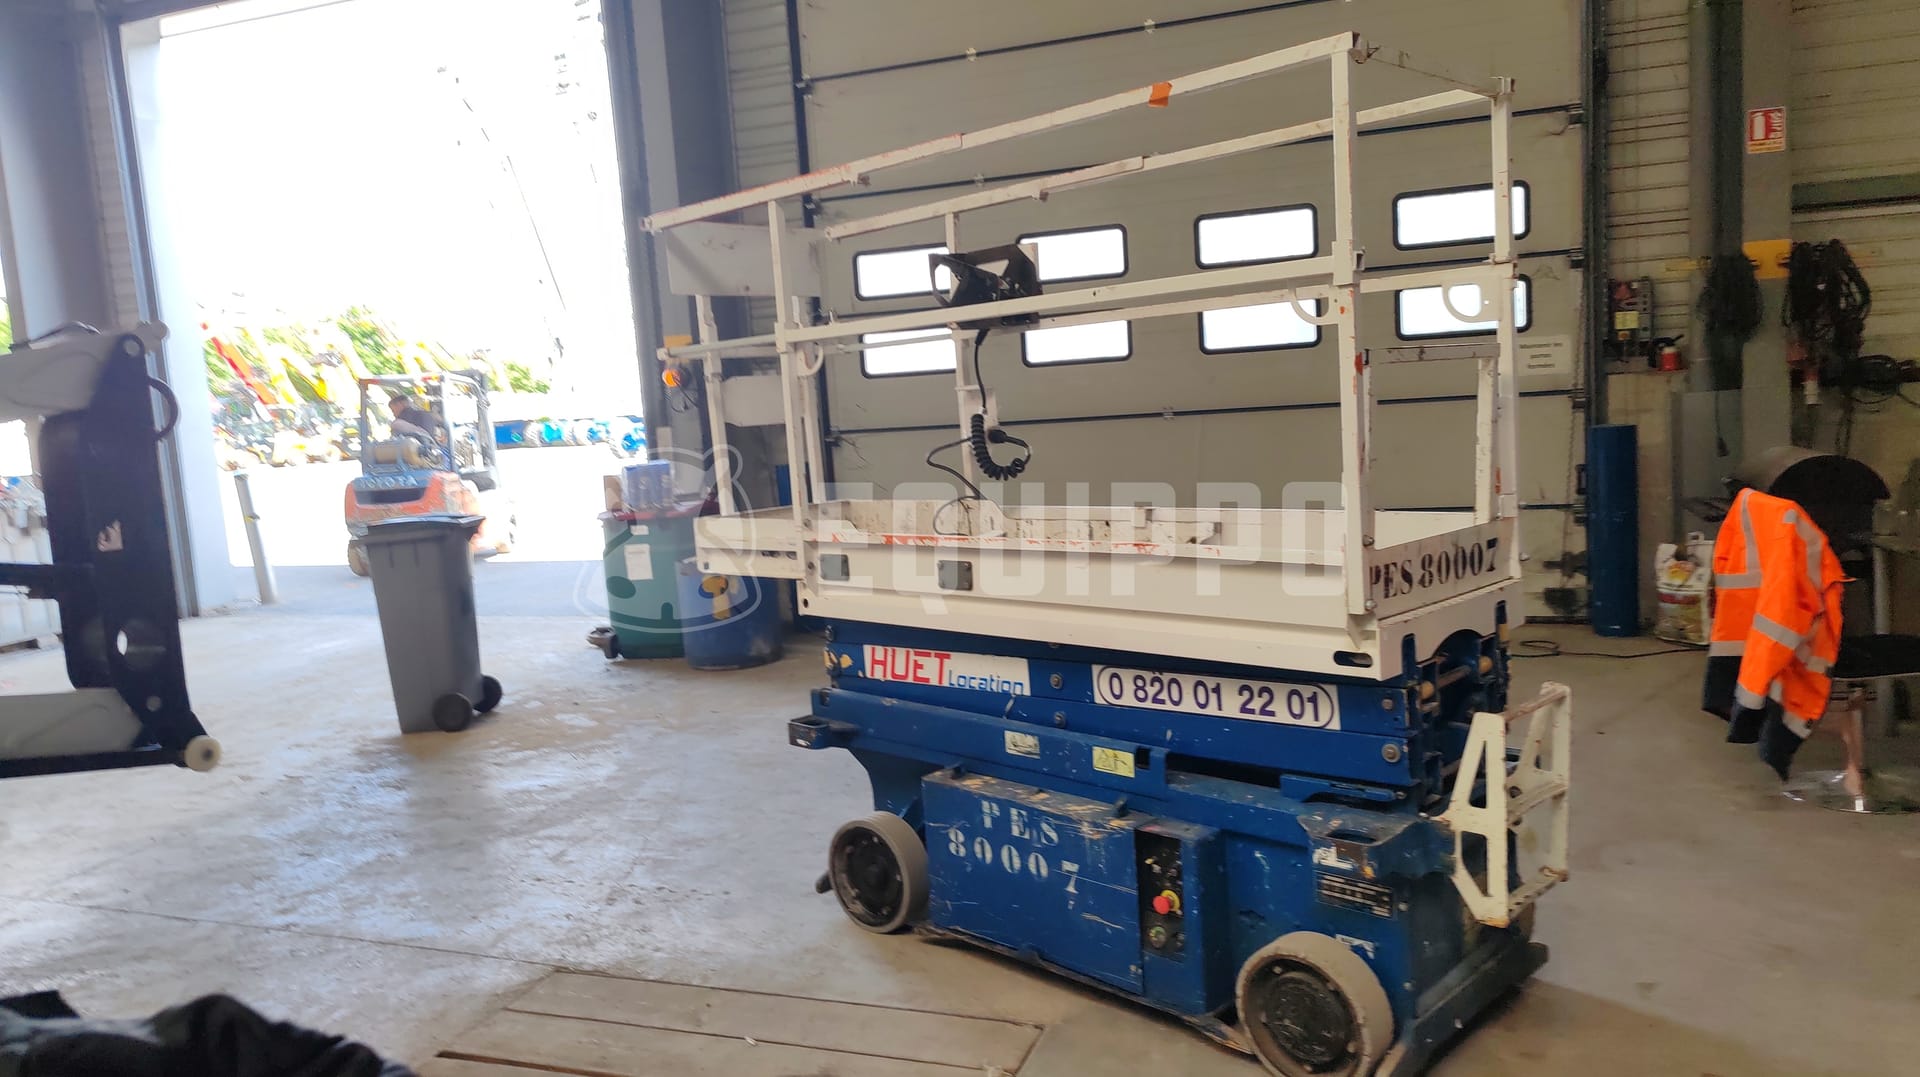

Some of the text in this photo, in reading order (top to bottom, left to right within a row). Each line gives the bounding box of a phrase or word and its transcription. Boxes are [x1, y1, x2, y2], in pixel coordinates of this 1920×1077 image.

[1369, 537, 1498, 599] PES 80007
[870, 647, 1024, 695] HUET Location
[1109, 672, 1319, 722] 0 820 01 22 01
[981, 800, 1059, 846] PES
[948, 828, 1080, 894] 80007
